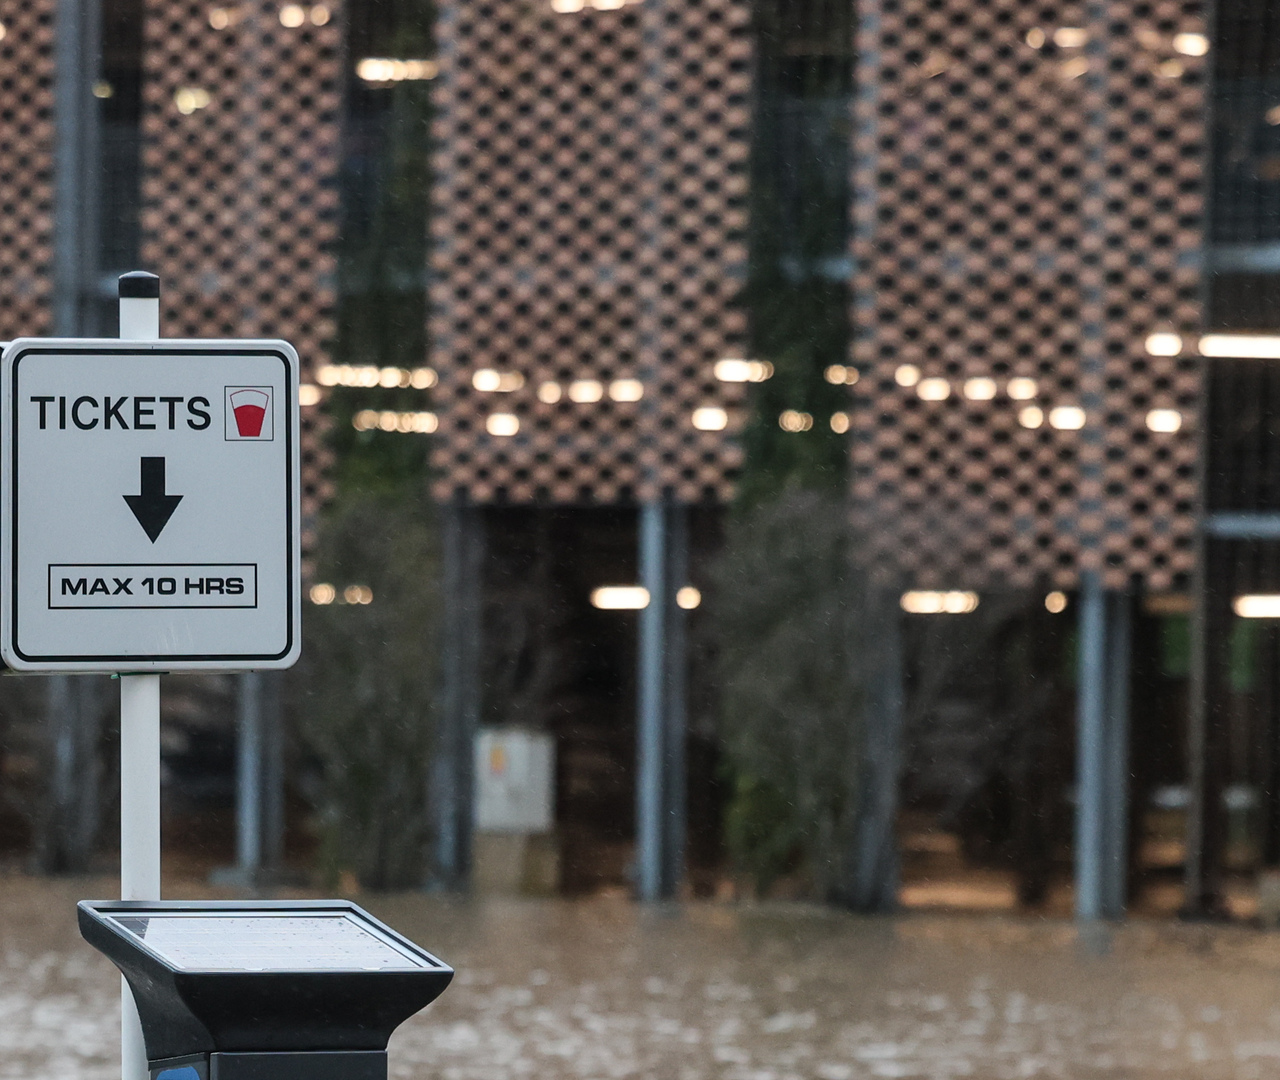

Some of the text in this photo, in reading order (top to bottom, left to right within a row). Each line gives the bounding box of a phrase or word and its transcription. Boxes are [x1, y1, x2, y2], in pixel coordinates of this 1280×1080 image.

[30, 395, 212, 431] TICKETS
[60, 576, 245, 596] MAX 10 HRS
